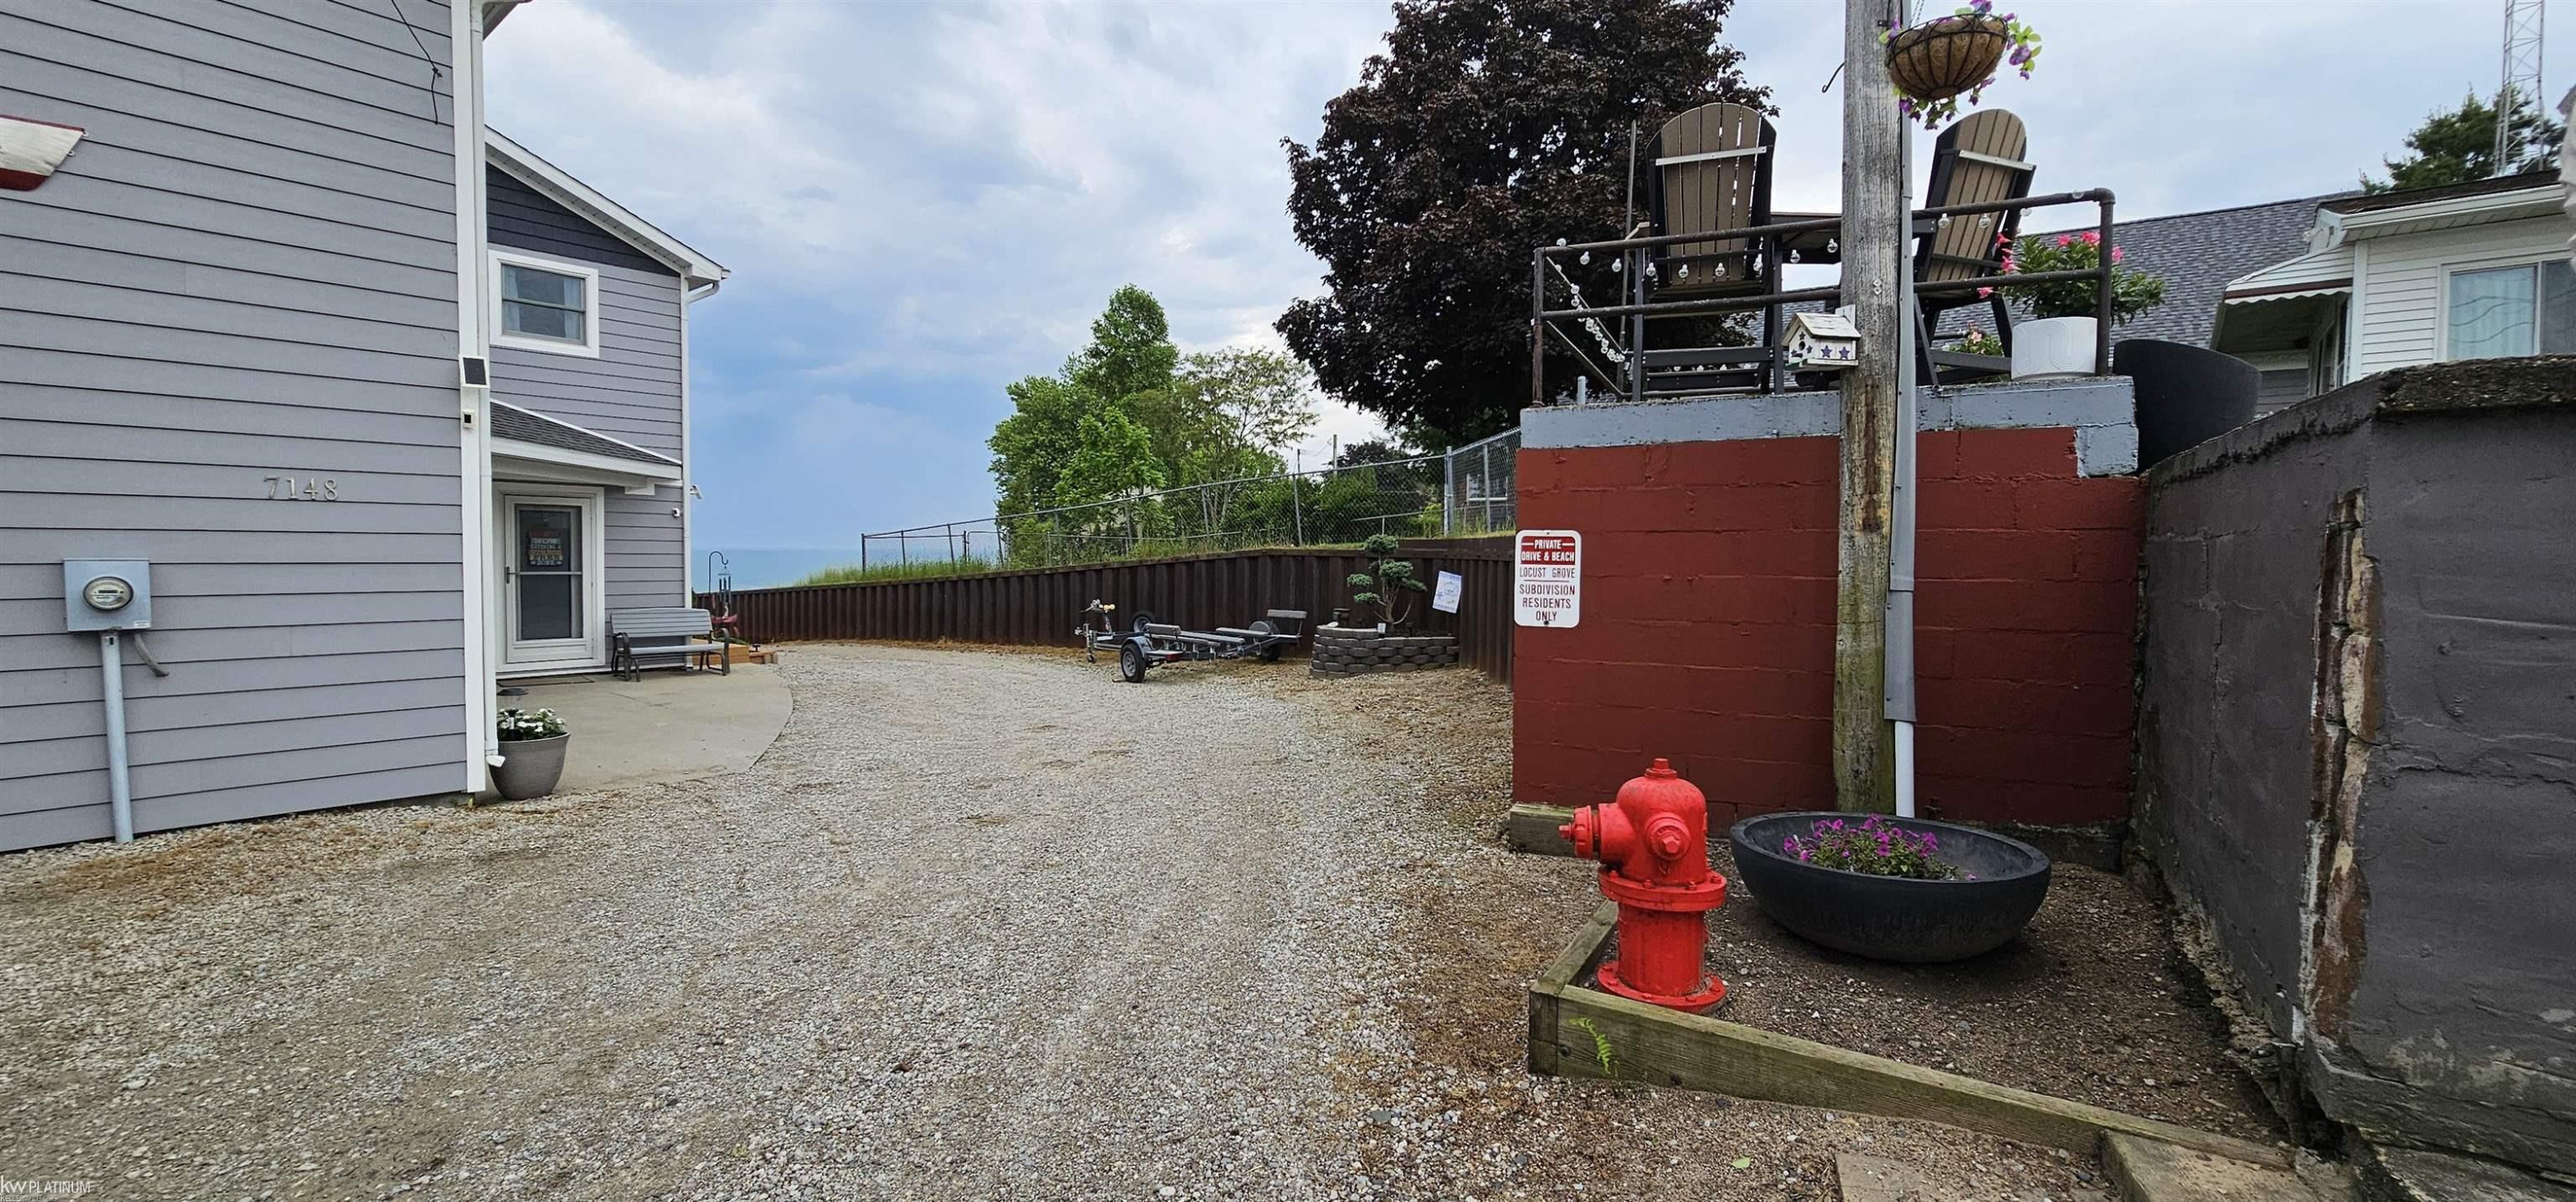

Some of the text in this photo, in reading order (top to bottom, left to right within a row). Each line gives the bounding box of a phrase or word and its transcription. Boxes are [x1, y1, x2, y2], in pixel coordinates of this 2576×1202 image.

[263, 477, 337, 501] 7148
[1534, 539, 1562, 549] PRIVATE
[1521, 551, 1575, 562] DRIVE & BEACH
[1519, 568, 1576, 578] LOCUST GROVE
[1519, 584, 1576, 595] SUBDIVISION
[1522, 597, 1571, 609] RESIDENTS
[1535, 610, 1557, 622] ONLY
